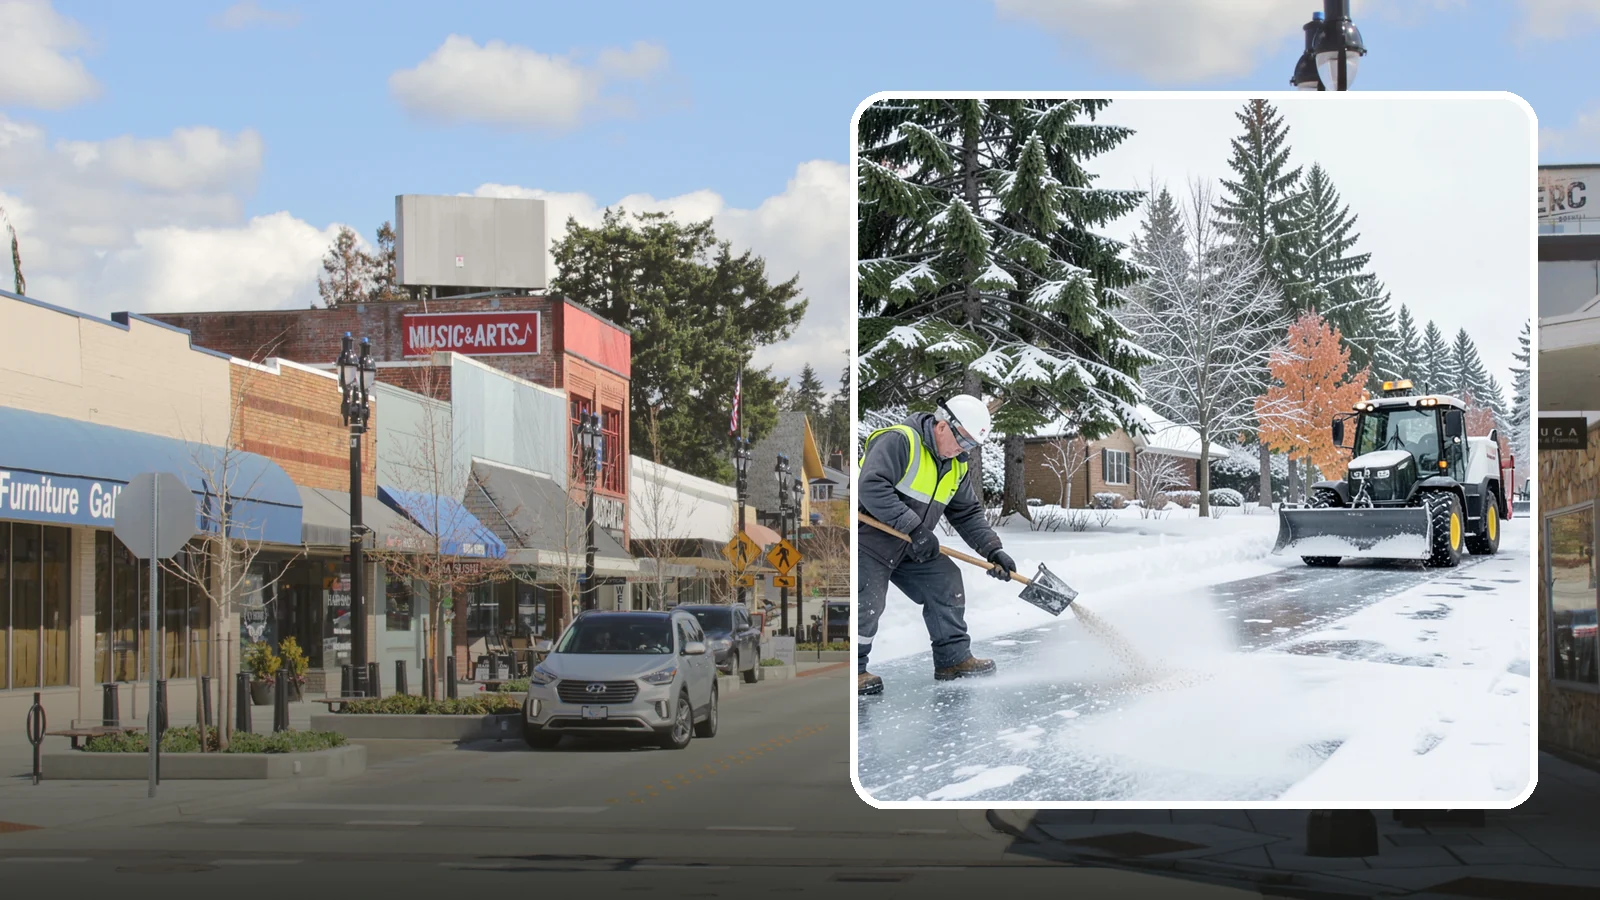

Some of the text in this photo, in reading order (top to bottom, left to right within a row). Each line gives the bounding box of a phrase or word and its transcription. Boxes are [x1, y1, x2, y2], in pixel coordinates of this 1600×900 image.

[0, 471, 122, 519] Furniture Gal
[453, 563, 479, 575] SUSHI
